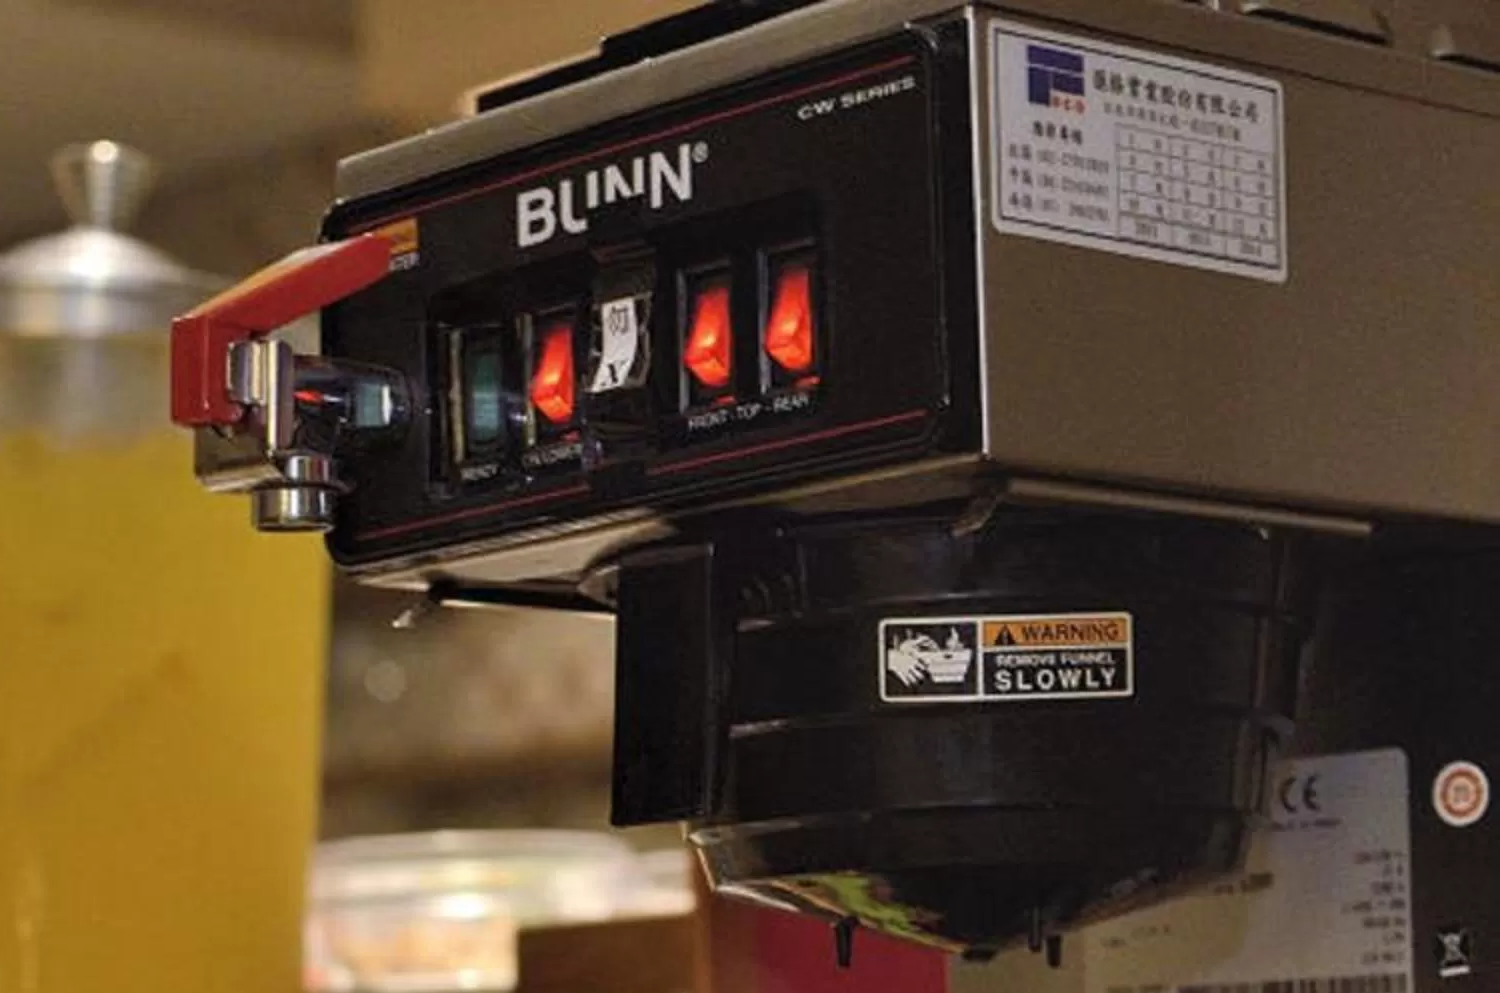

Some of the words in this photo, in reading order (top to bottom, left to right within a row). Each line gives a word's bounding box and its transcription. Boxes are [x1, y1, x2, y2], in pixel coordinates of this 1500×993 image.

[840, 75, 916, 108] SERIES
[1020, 622, 1119, 642] WARNING
[995, 668, 1117, 691] SLOWLY
